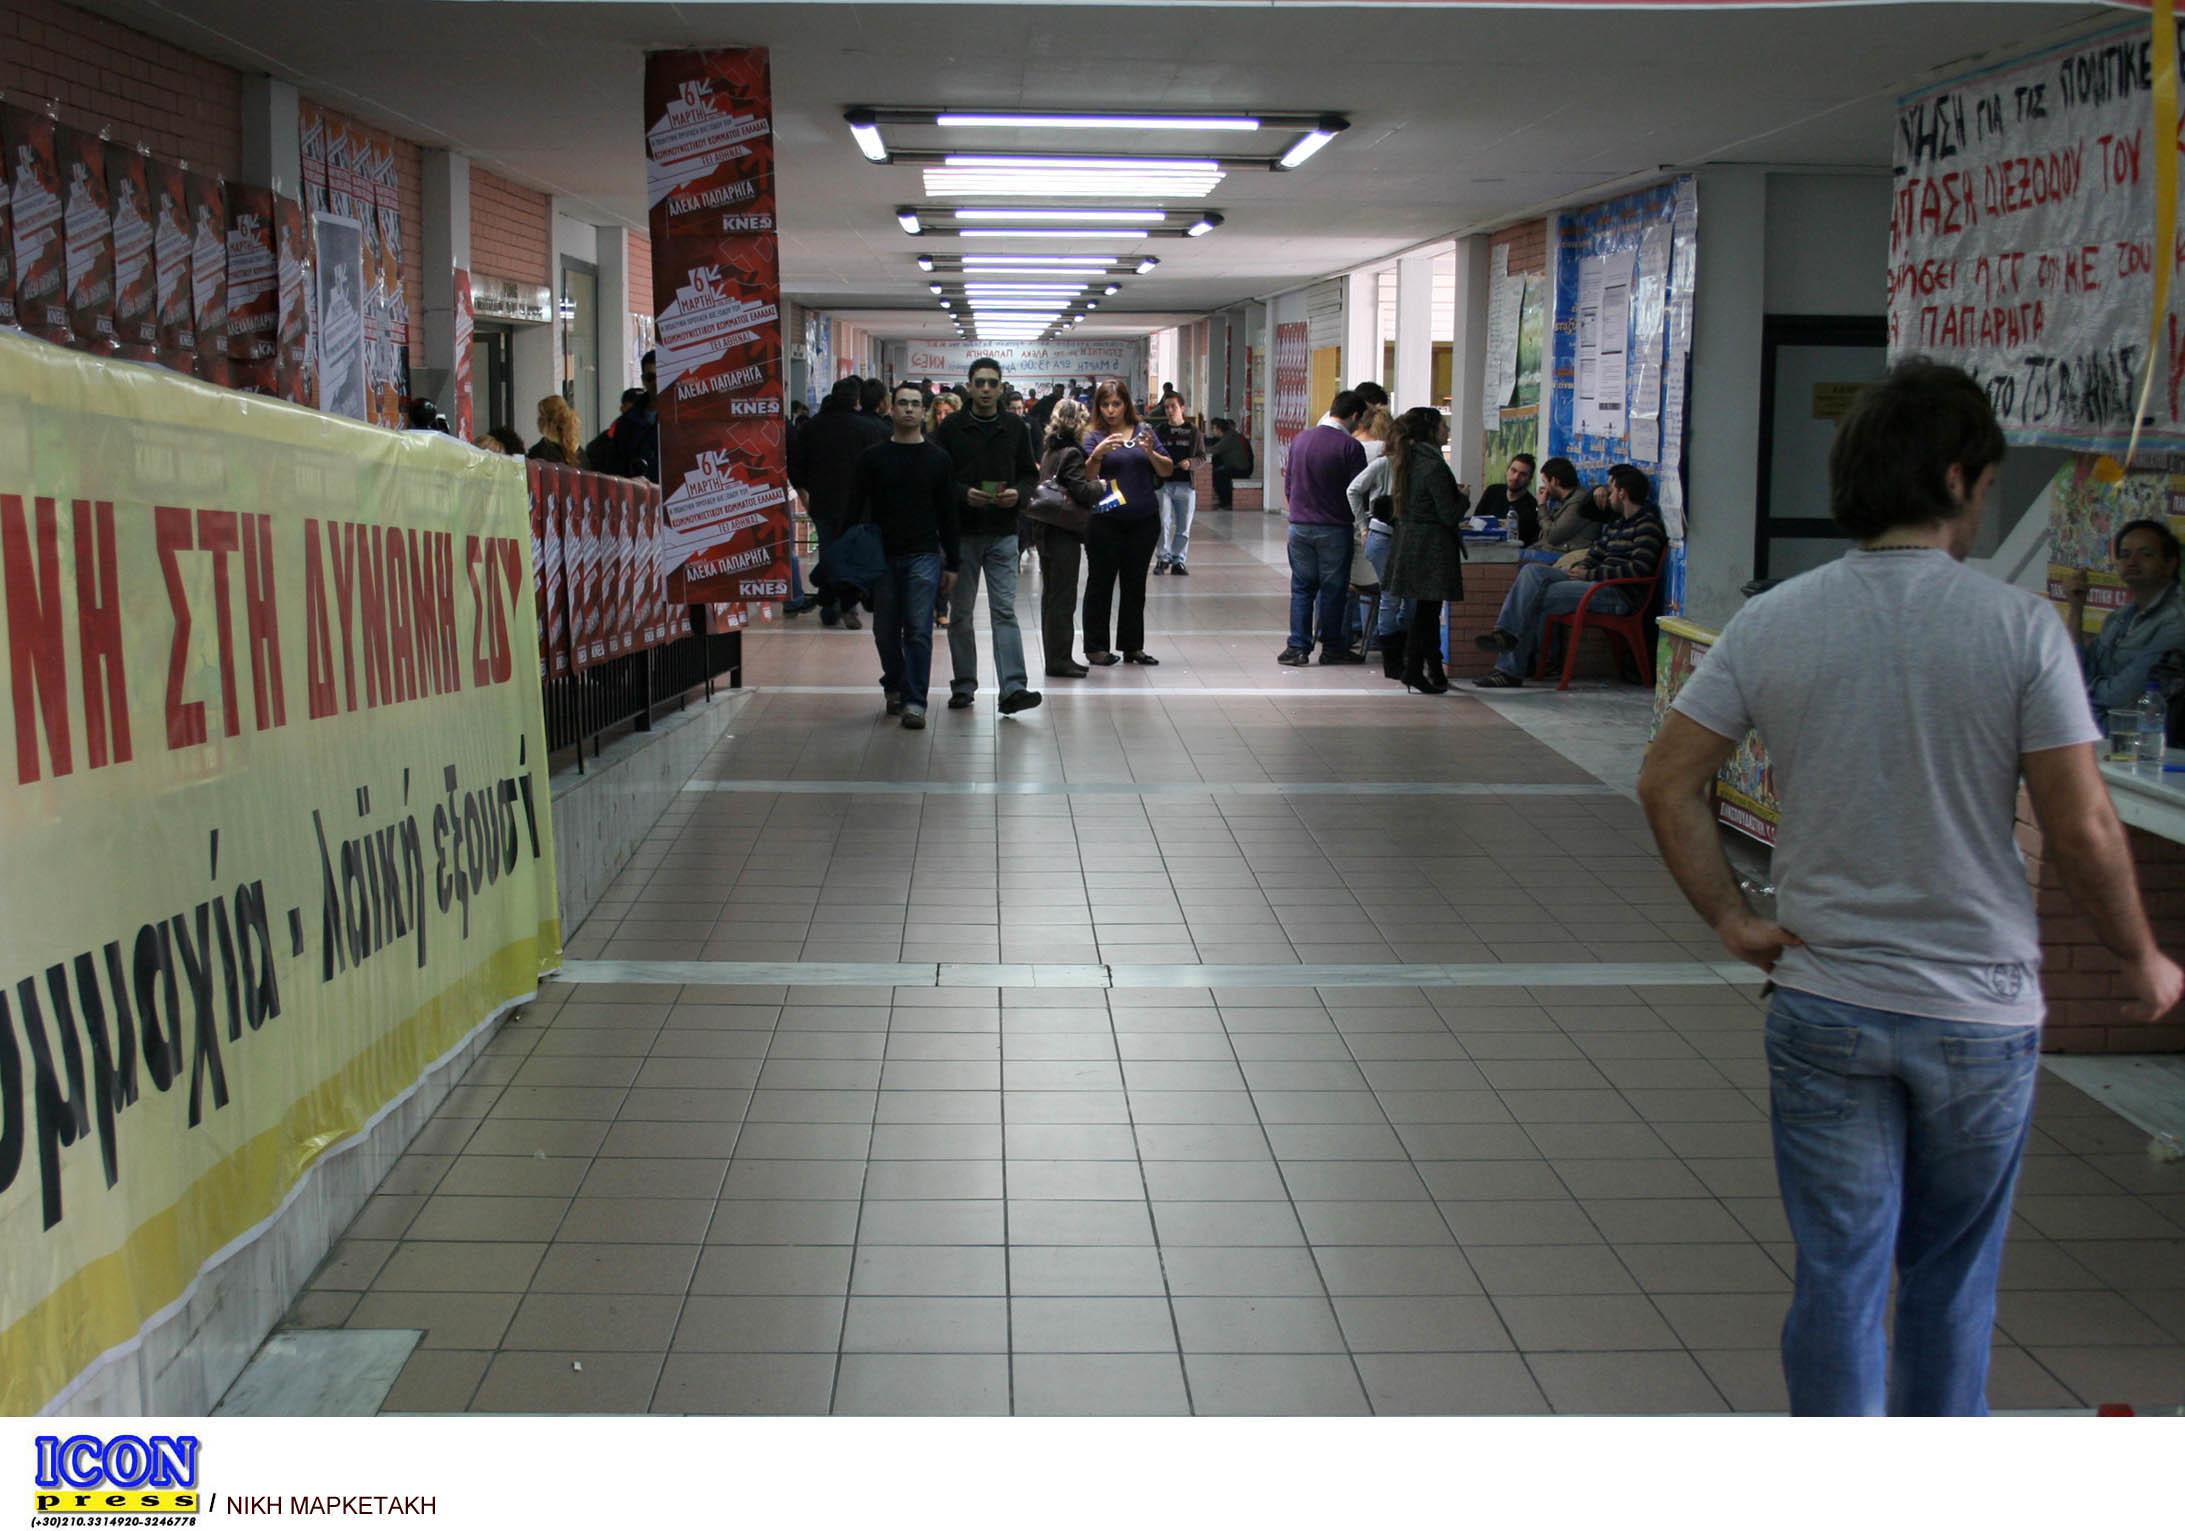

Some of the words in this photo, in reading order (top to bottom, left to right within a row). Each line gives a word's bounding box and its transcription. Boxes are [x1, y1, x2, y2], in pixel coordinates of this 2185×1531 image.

[684, 84, 695, 106] 6
[672, 110, 705, 127] ΜΑΡΤΗ
[742, 121, 767, 135] ΕΛΛΑΔΑΣ
[2097, 128, 2142, 194] ΤΟΥ
[669, 196, 701, 216] ΑΛΕΚΑ
[703, 181, 755, 207] ΠΑΠΑΡΗΓΑ
[723, 218, 760, 231] ΚΝΕ
[693, 268, 704, 292] 6
[681, 295, 713, 314] ΜΑΡΤΗ
[750, 307, 776, 322] ΕΛΛΑΔΑΣ
[1920, 300, 2044, 348] ΠΑΠΑΡΗΓΑ
[678, 380, 710, 401] ΑΛΕΚΑ
[711, 366, 762, 392] ΠΑΠΑΡΗΓΑ
[731, 402, 768, 415] ΚΝΕ
[701, 452, 712, 476] 6
[690, 478, 721, 496] ΜΑΡΤΗ
[758, 490, 783, 504] ΕΛΛΑΔΑΣ
[687, 563, 717, 582] ΑΛΕΚΑ
[719, 548, 771, 575] ΠΑΠΑΡΗΓΑ
[739, 583, 776, 596] ΚΝΕ
[155, 506, 287, 750] ΣΤΗ
[305, 518, 461, 720] ΔΥΝΑΜΗ
[312, 768, 427, 983] λαϊκή
